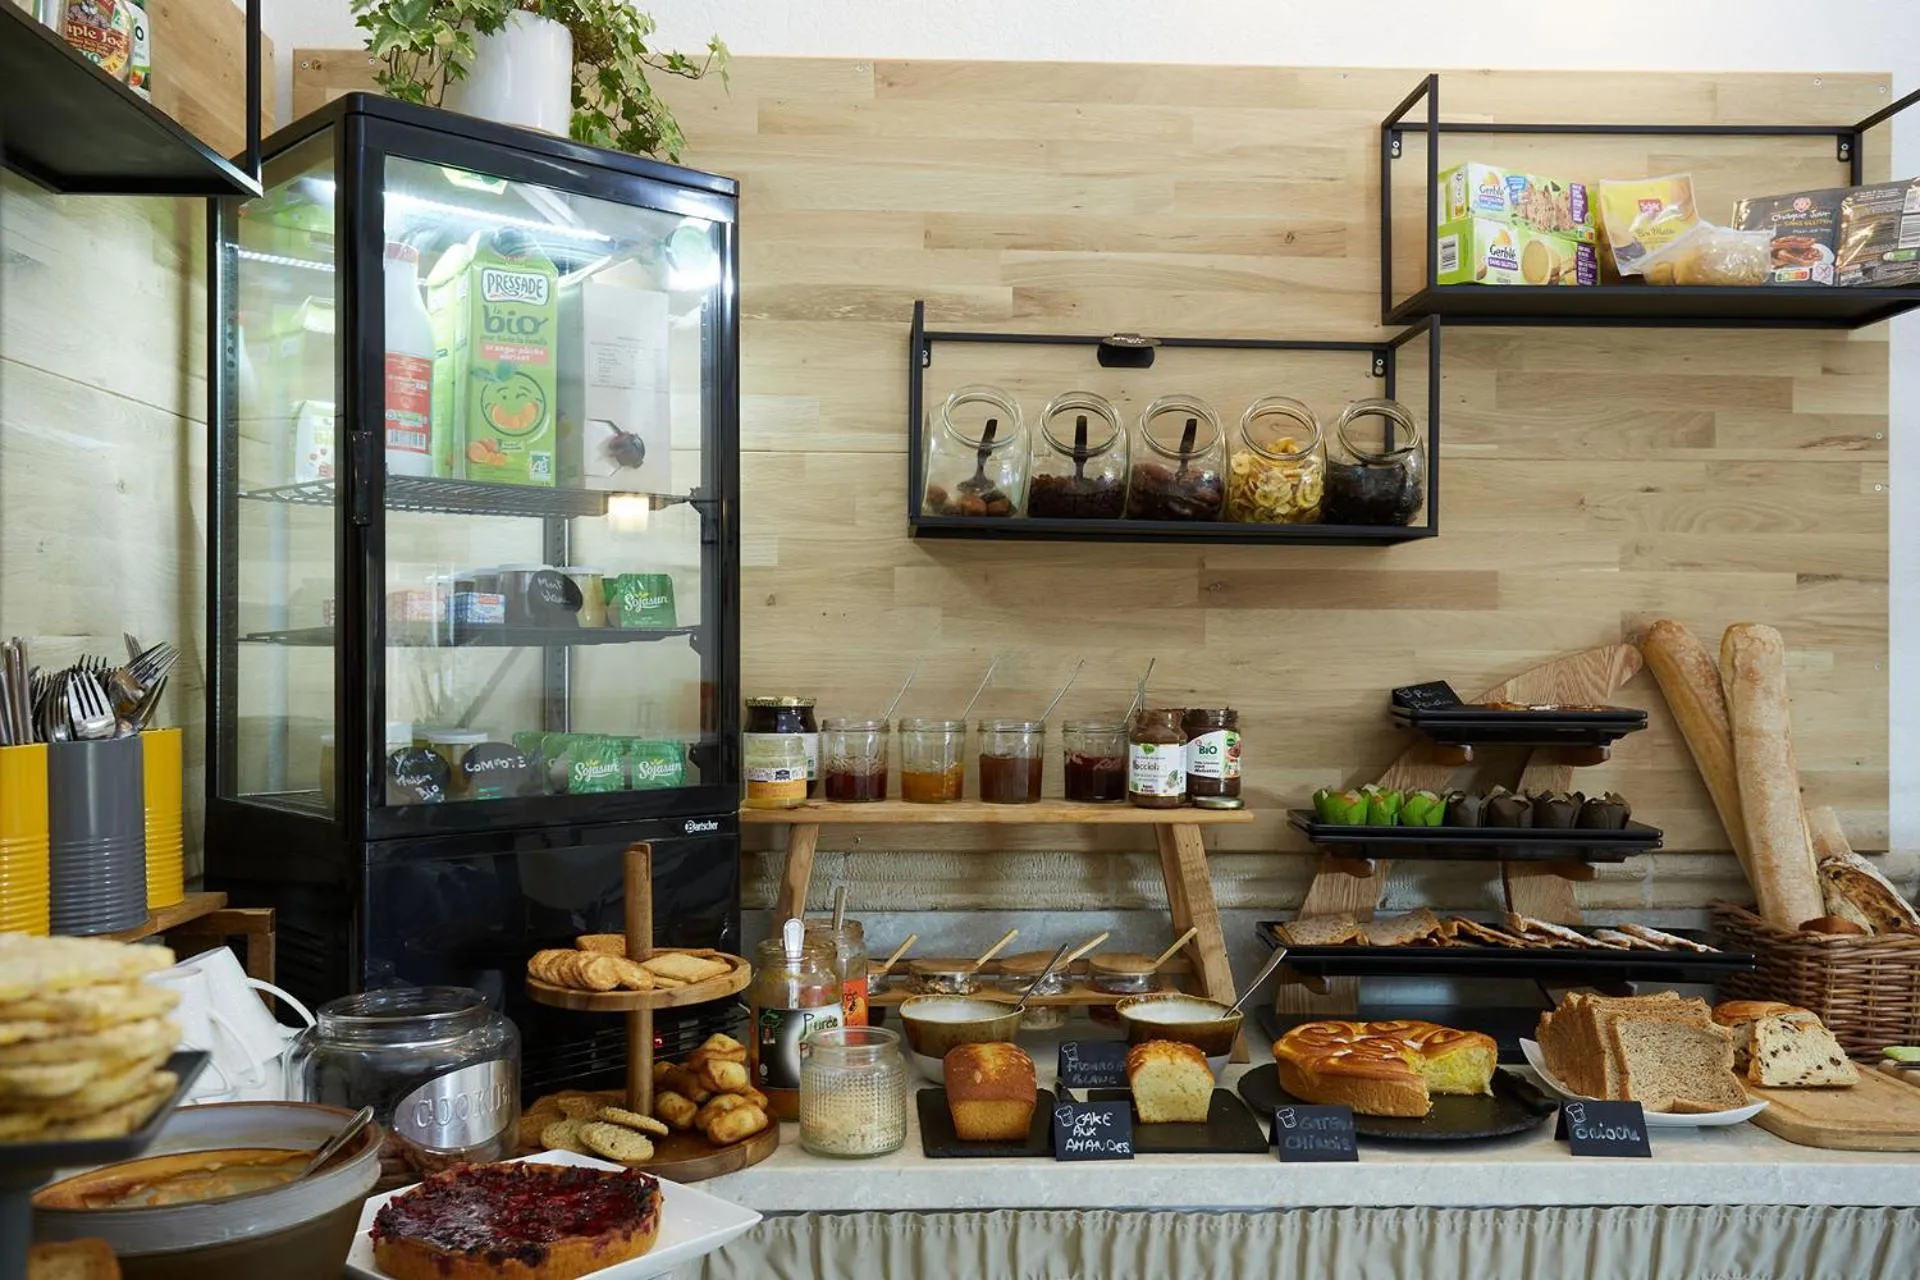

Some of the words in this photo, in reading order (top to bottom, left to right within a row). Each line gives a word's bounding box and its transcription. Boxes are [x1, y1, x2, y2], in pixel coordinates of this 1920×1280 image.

[486, 272, 544, 298] PRESSADE
[482, 304, 549, 335] bio
[1199, 745, 1218, 755] BIO
[575, 761, 619, 781] Sojasun
[639, 760, 682, 780] Sojasun
[1075, 1112, 1113, 1127] CAKE
[1065, 1138, 1131, 1154] AMANDES
